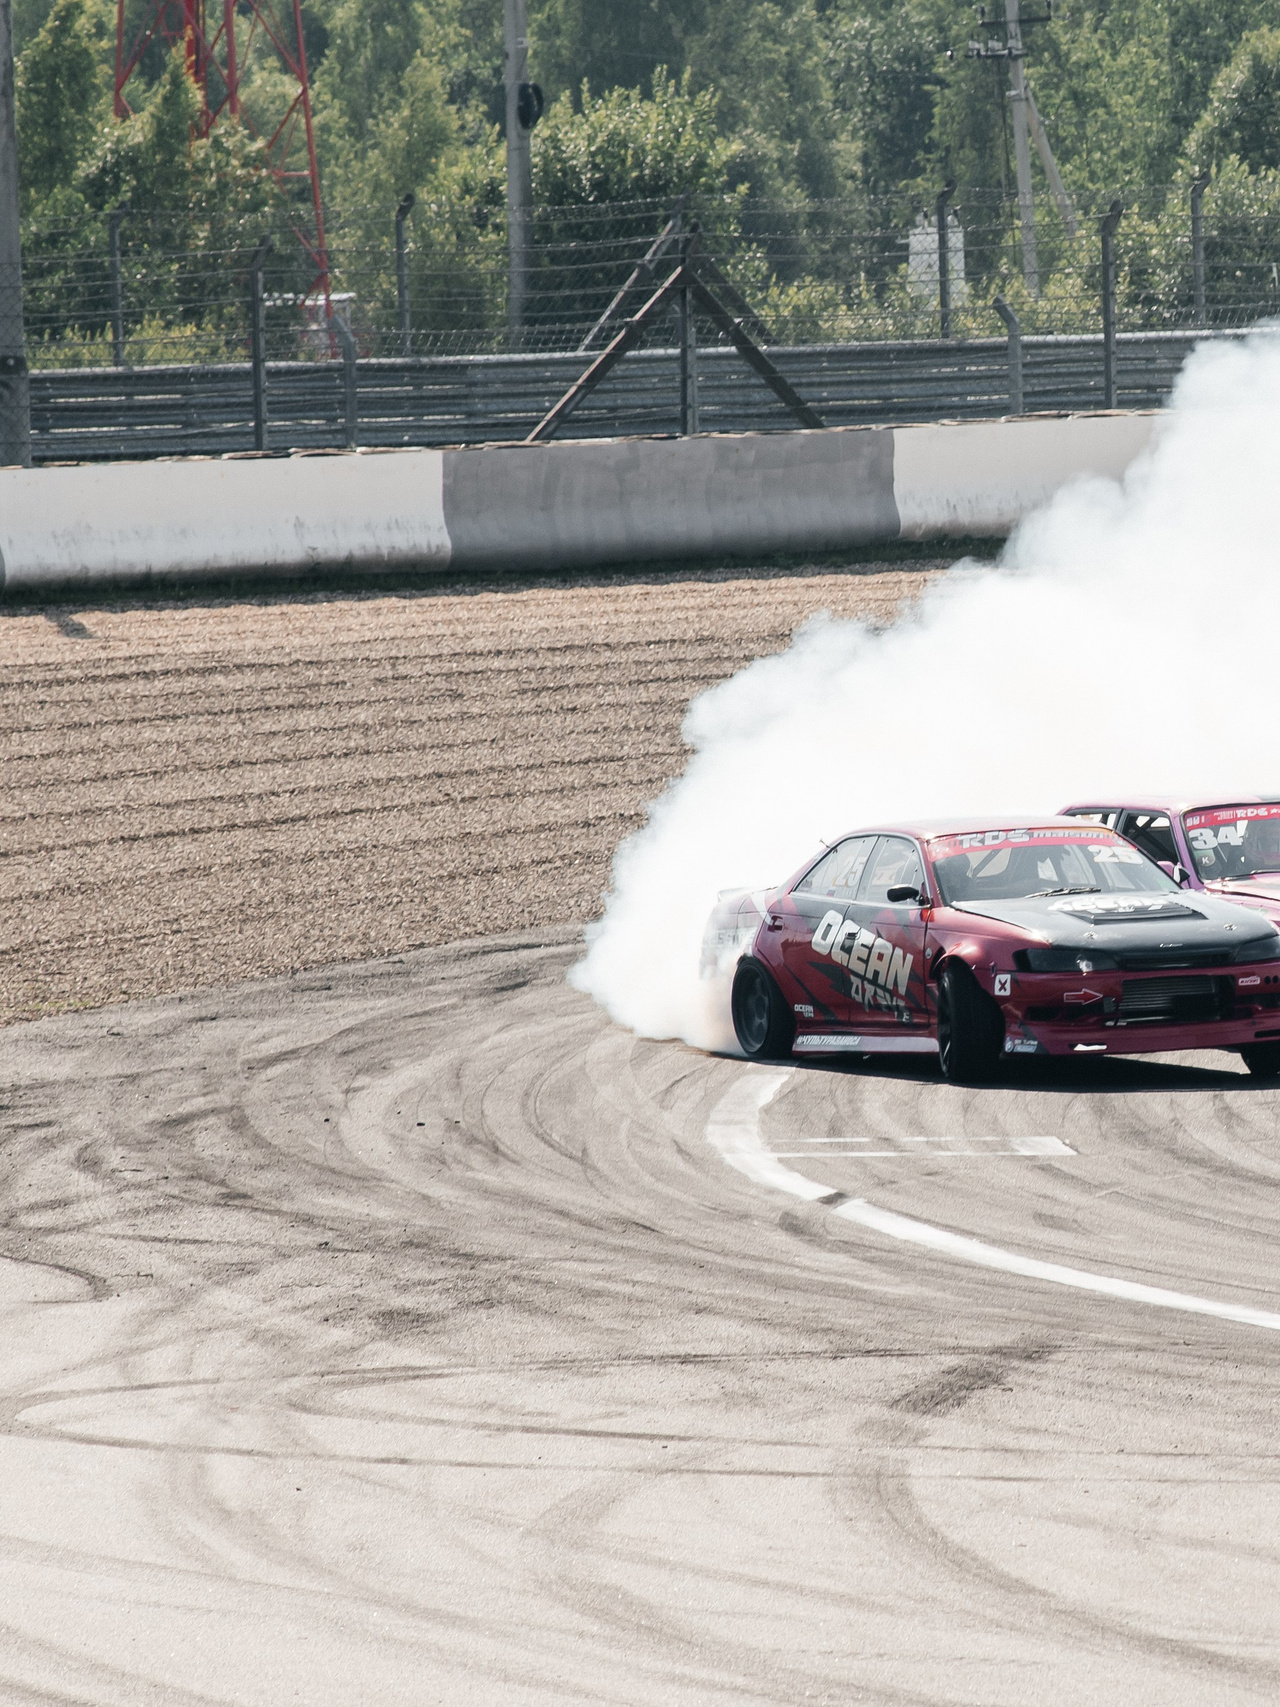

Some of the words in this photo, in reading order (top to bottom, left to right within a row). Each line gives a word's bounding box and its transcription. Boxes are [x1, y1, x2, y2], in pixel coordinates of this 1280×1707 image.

[957, 828, 1030, 848] RDS
[1188, 826, 1243, 850] 34
[1087, 844, 1144, 864] 25
[811, 909, 914, 996] OCEAN
